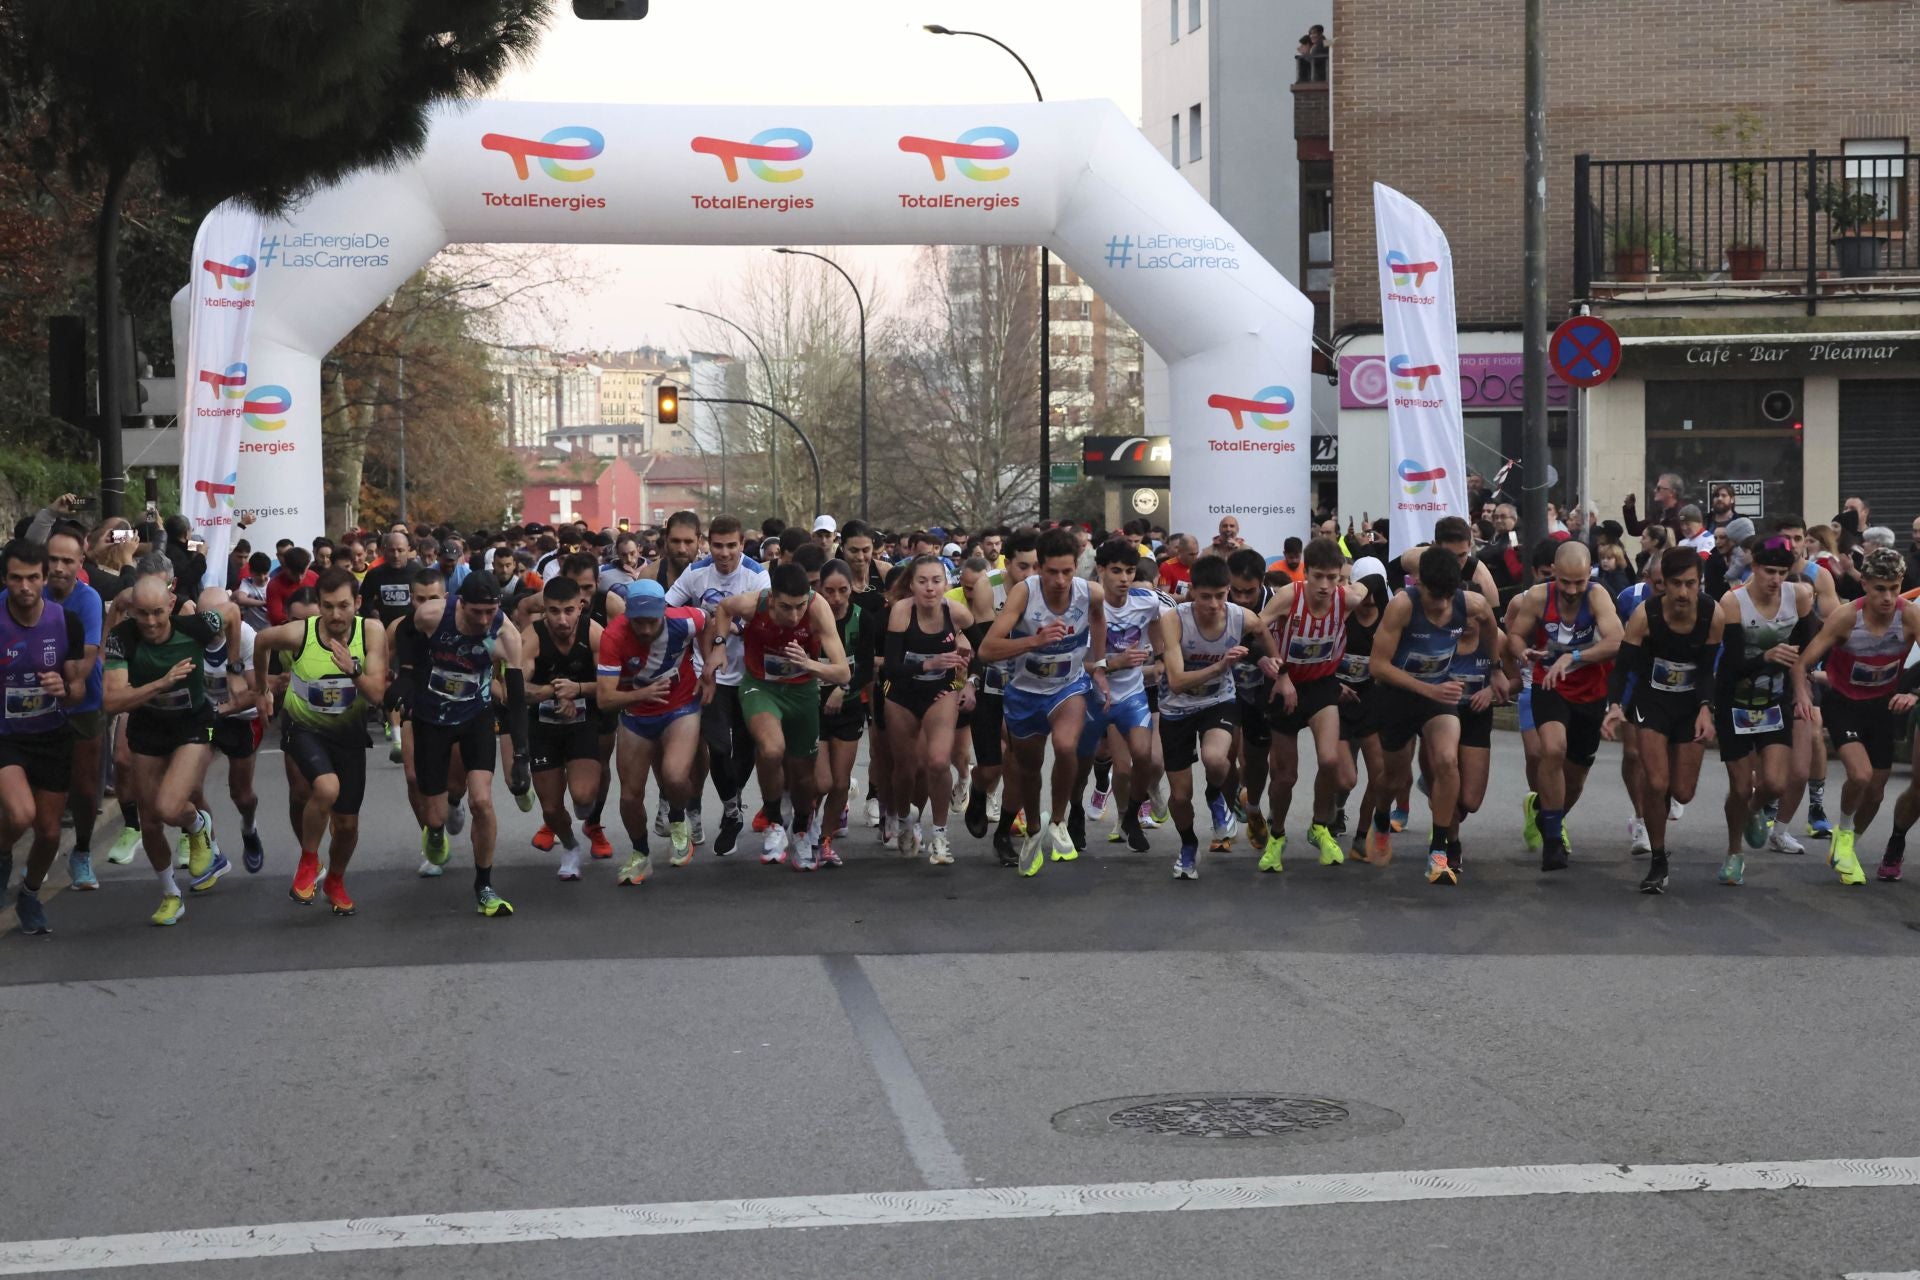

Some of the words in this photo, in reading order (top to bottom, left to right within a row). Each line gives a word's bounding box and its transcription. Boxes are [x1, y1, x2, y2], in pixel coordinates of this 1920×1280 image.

[482, 192, 606, 211] TotalEnergies
[691, 195, 814, 212] TotalEnergies
[898, 193, 1020, 211] TotalEnergies
[282, 251, 389, 267] LasCarreras
[1137, 252, 1240, 270] LasCarreras
[1686, 345, 1730, 367] Café
[1750, 345, 1789, 362] Bar
[1208, 439, 1296, 454] TotalEnergies
[1208, 504, 1296, 515] totalenergies.es
[6, 648, 19, 659] kp
[322, 688, 342, 704] 55
